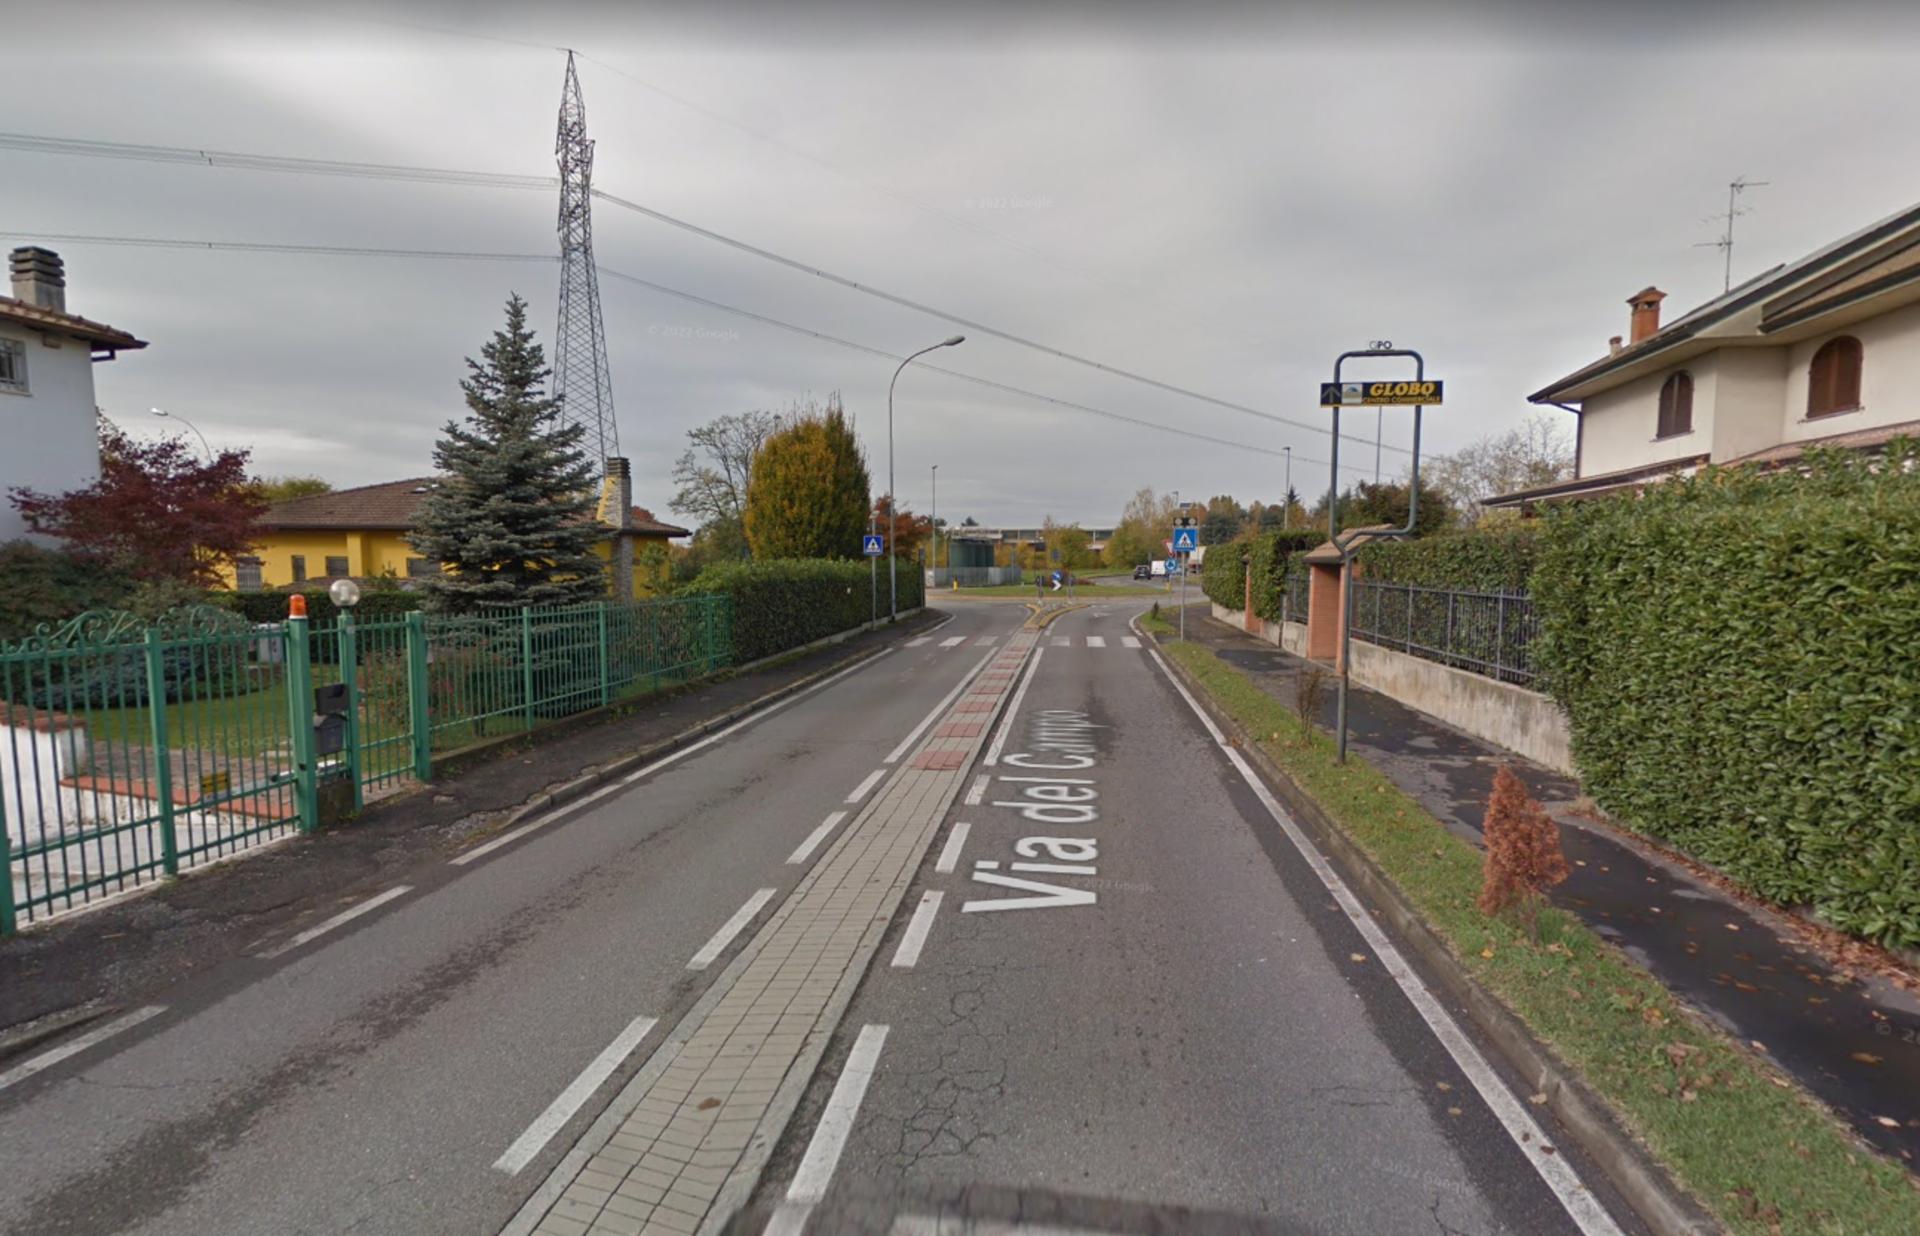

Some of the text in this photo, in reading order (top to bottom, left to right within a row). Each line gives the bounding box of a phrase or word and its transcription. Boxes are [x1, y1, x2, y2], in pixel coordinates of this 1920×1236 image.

[1370, 383, 1434, 397] GLOBO
[993, 776, 1098, 823] del
[961, 836, 1098, 913] Via
